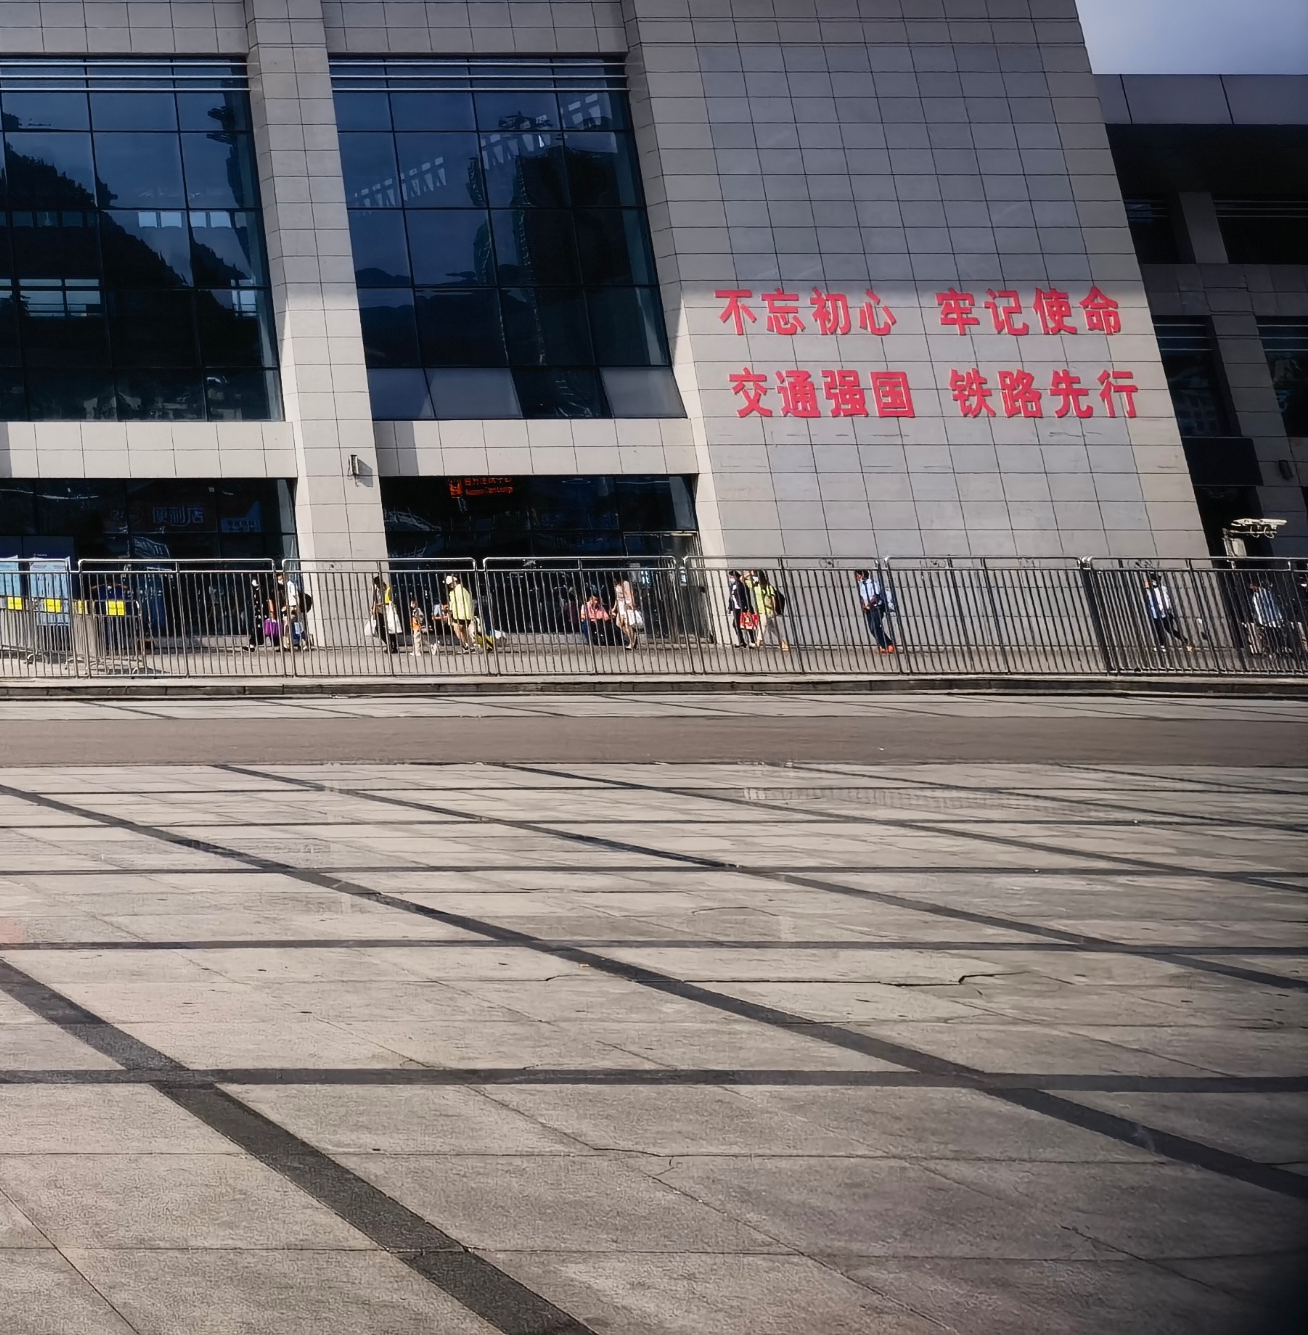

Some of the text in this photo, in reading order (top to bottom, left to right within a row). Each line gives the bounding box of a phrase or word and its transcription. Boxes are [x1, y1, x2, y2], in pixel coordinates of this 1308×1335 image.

[715, 286, 1122, 336] 不忘初心 牢记使命
[728, 367, 1139, 418] 交通强国 铁路先行
